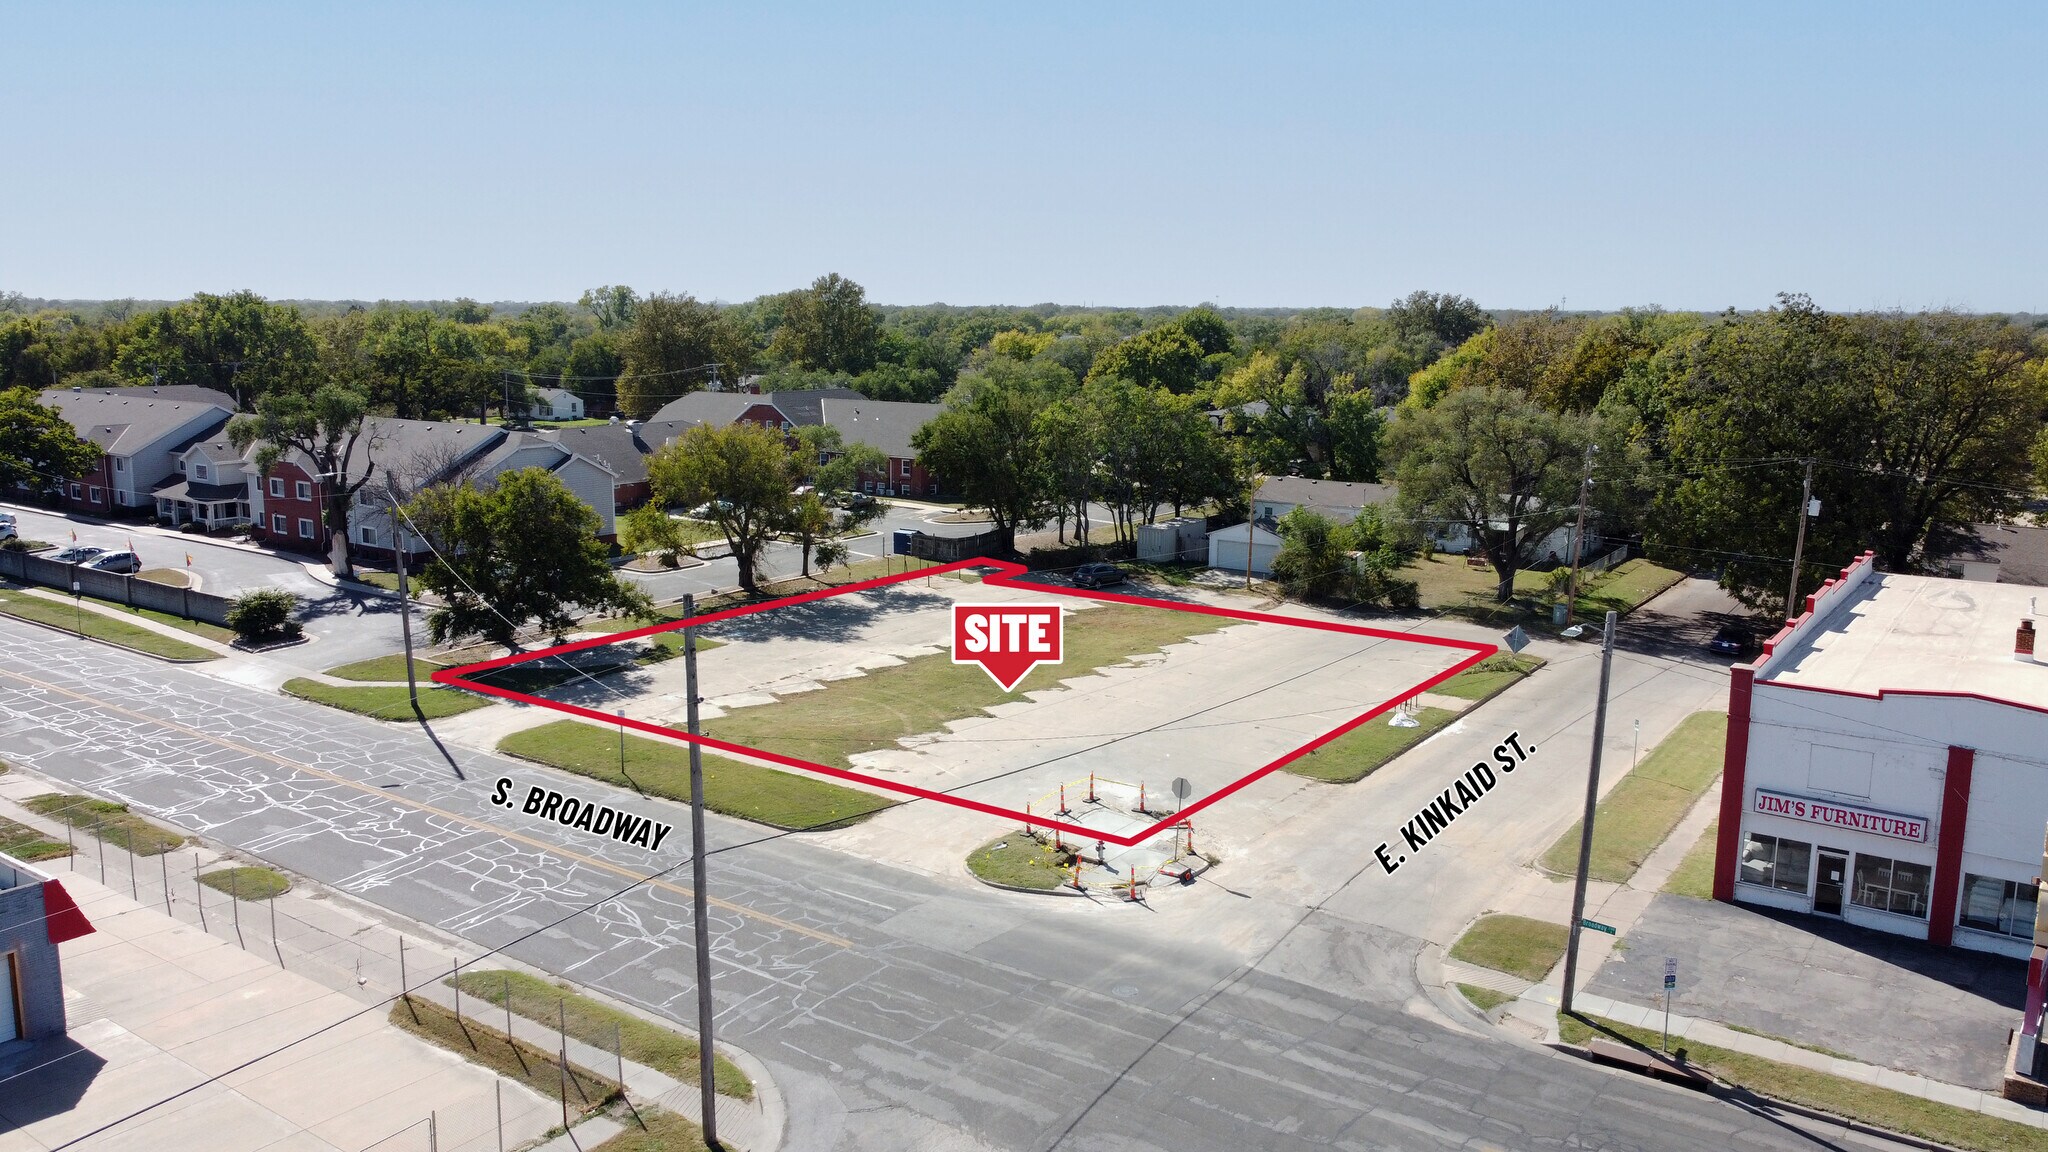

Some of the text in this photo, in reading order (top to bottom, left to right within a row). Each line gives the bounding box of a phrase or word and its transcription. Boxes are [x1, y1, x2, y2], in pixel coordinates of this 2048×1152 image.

[1758, 795, 1921, 839] JIM'S FURNITURE
[1582, 919, 1607, 933] Broadway
